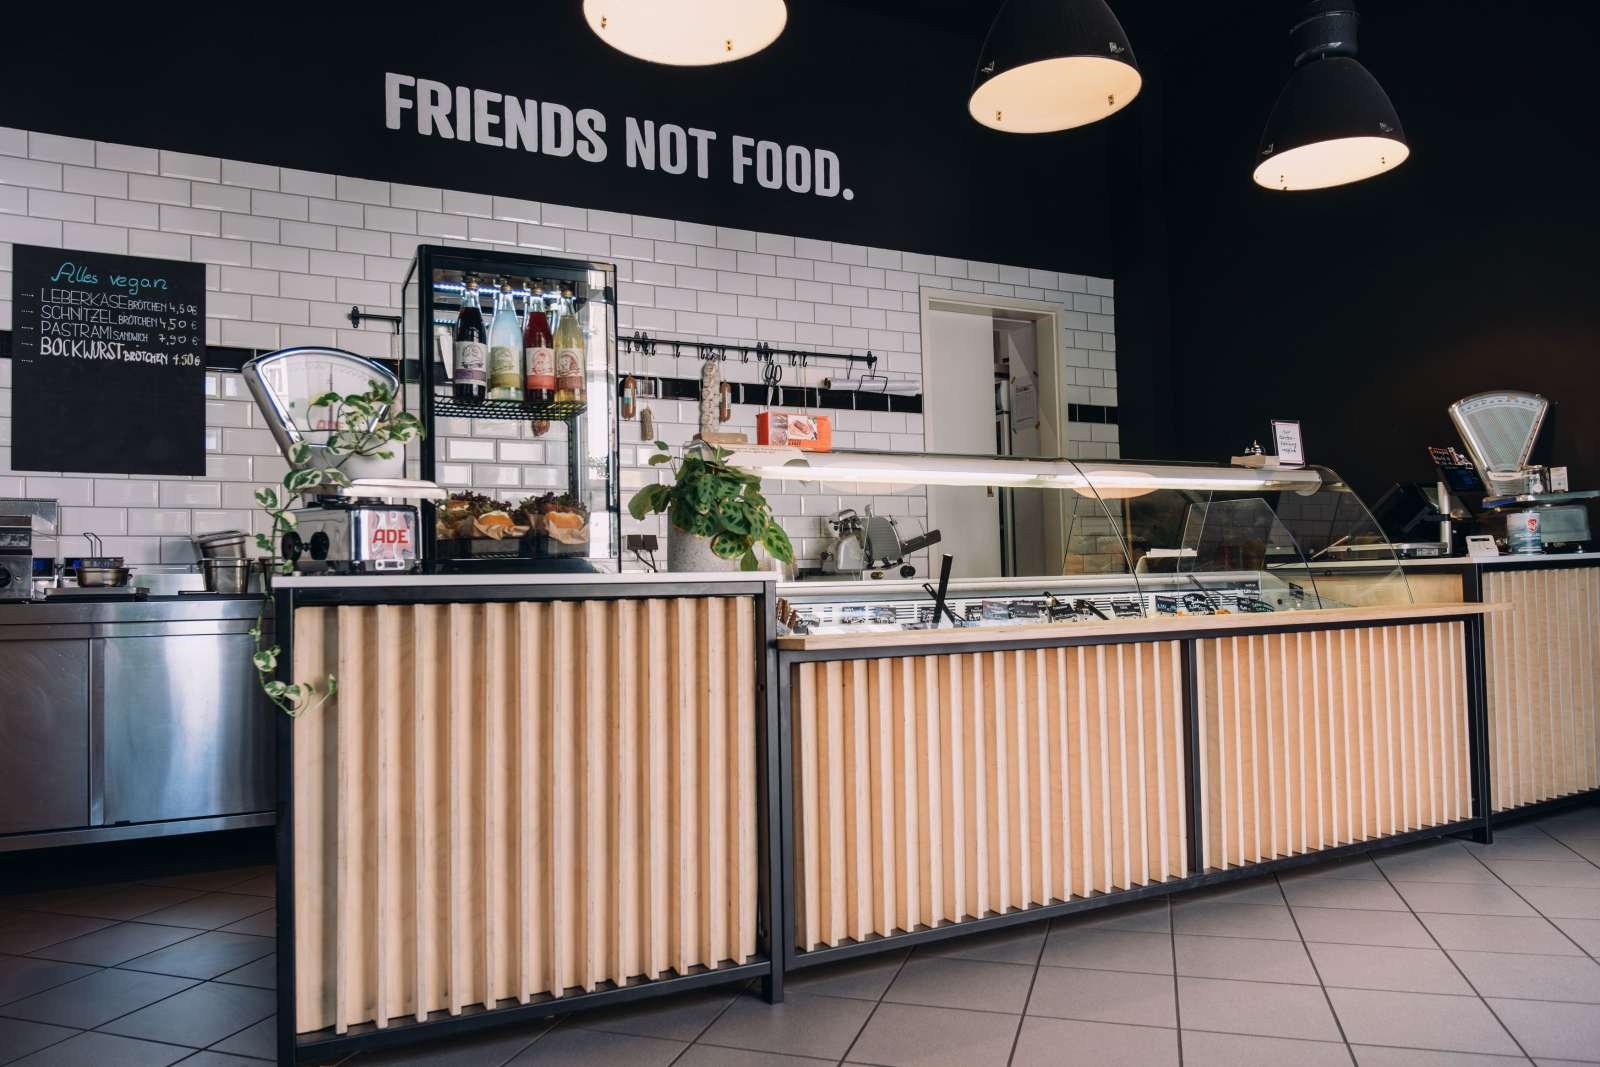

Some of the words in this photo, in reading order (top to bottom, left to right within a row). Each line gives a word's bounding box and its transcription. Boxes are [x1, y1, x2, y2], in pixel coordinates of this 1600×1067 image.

[385, 72, 608, 163] FRIENDS
[625, 116, 717, 180] NOT
[732, 135, 855, 201] FOOD.
[51, 262, 98, 284] Alles
[109, 275, 168, 295] vegan
[40, 336, 125, 360] BOCKWURST
[372, 529, 409, 544] ADE
